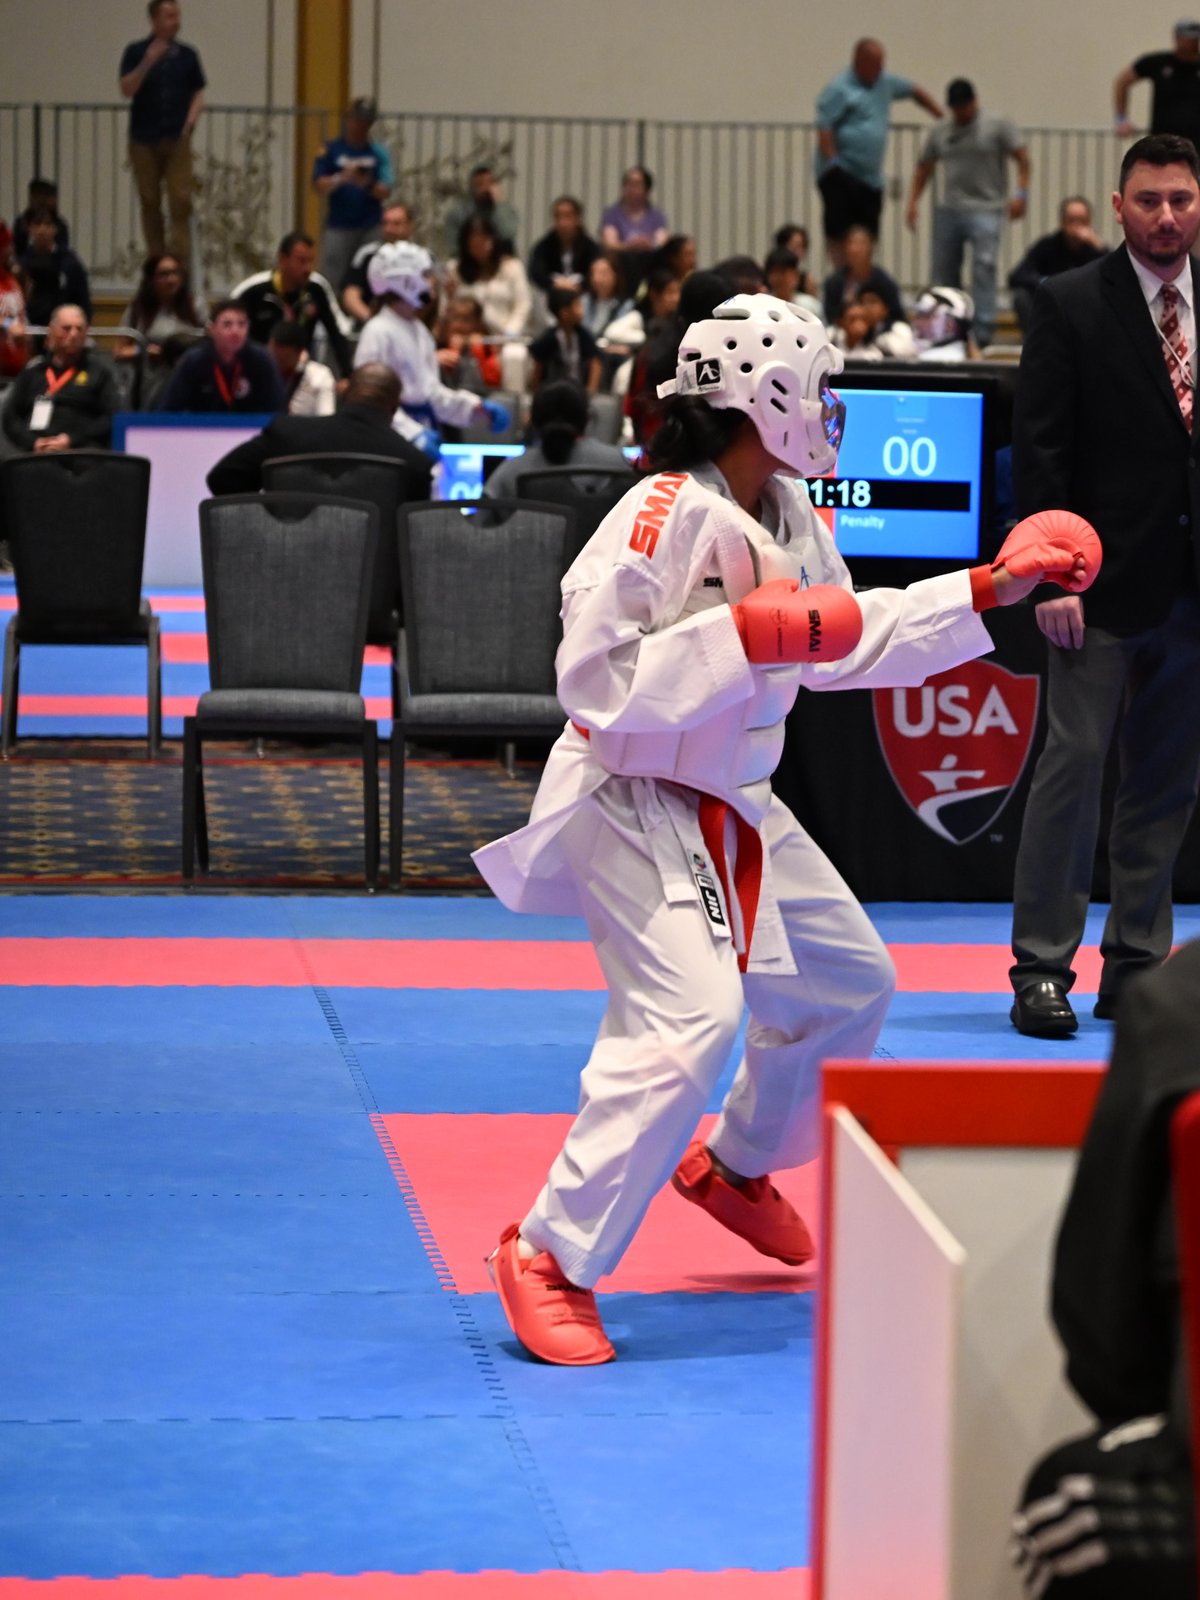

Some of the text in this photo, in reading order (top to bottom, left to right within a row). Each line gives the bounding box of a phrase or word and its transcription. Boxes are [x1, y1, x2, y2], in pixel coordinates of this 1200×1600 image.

[883, 436, 937, 477] 00
[840, 514, 885, 530] Penalty
[808, 609, 822, 653] SMAI
[892, 684, 1020, 738] USA
[705, 889, 722, 920] JIN
